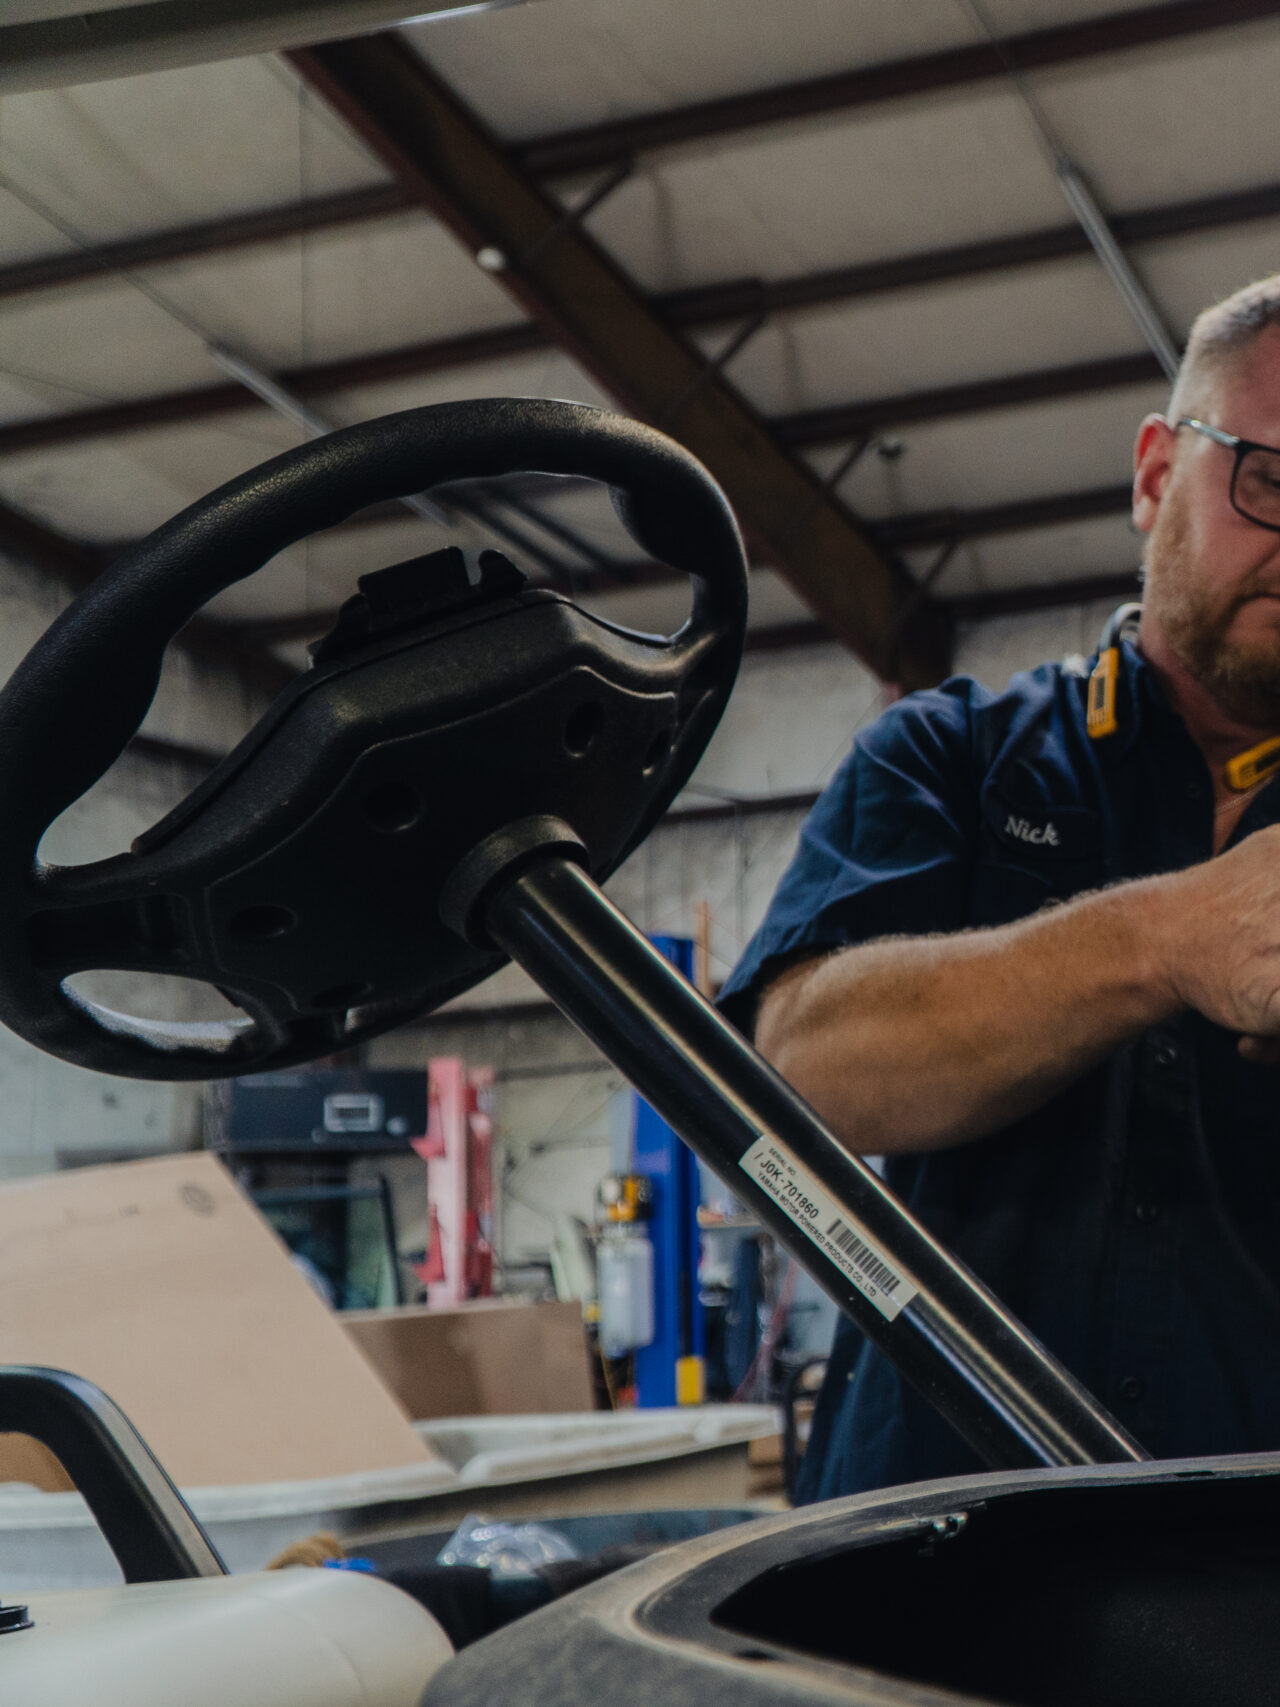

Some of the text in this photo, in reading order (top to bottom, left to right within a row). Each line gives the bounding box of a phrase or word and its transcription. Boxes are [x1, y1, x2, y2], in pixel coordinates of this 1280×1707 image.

[1005, 815, 1061, 846] Nick
[768, 1147, 787, 1168] SERIAL
[758, 1170, 781, 1196] YAMAHA
[779, 1194, 800, 1217] MOTOR
[798, 1214, 826, 1244] POWERED
[824, 1241, 854, 1274] PRODUCTS
